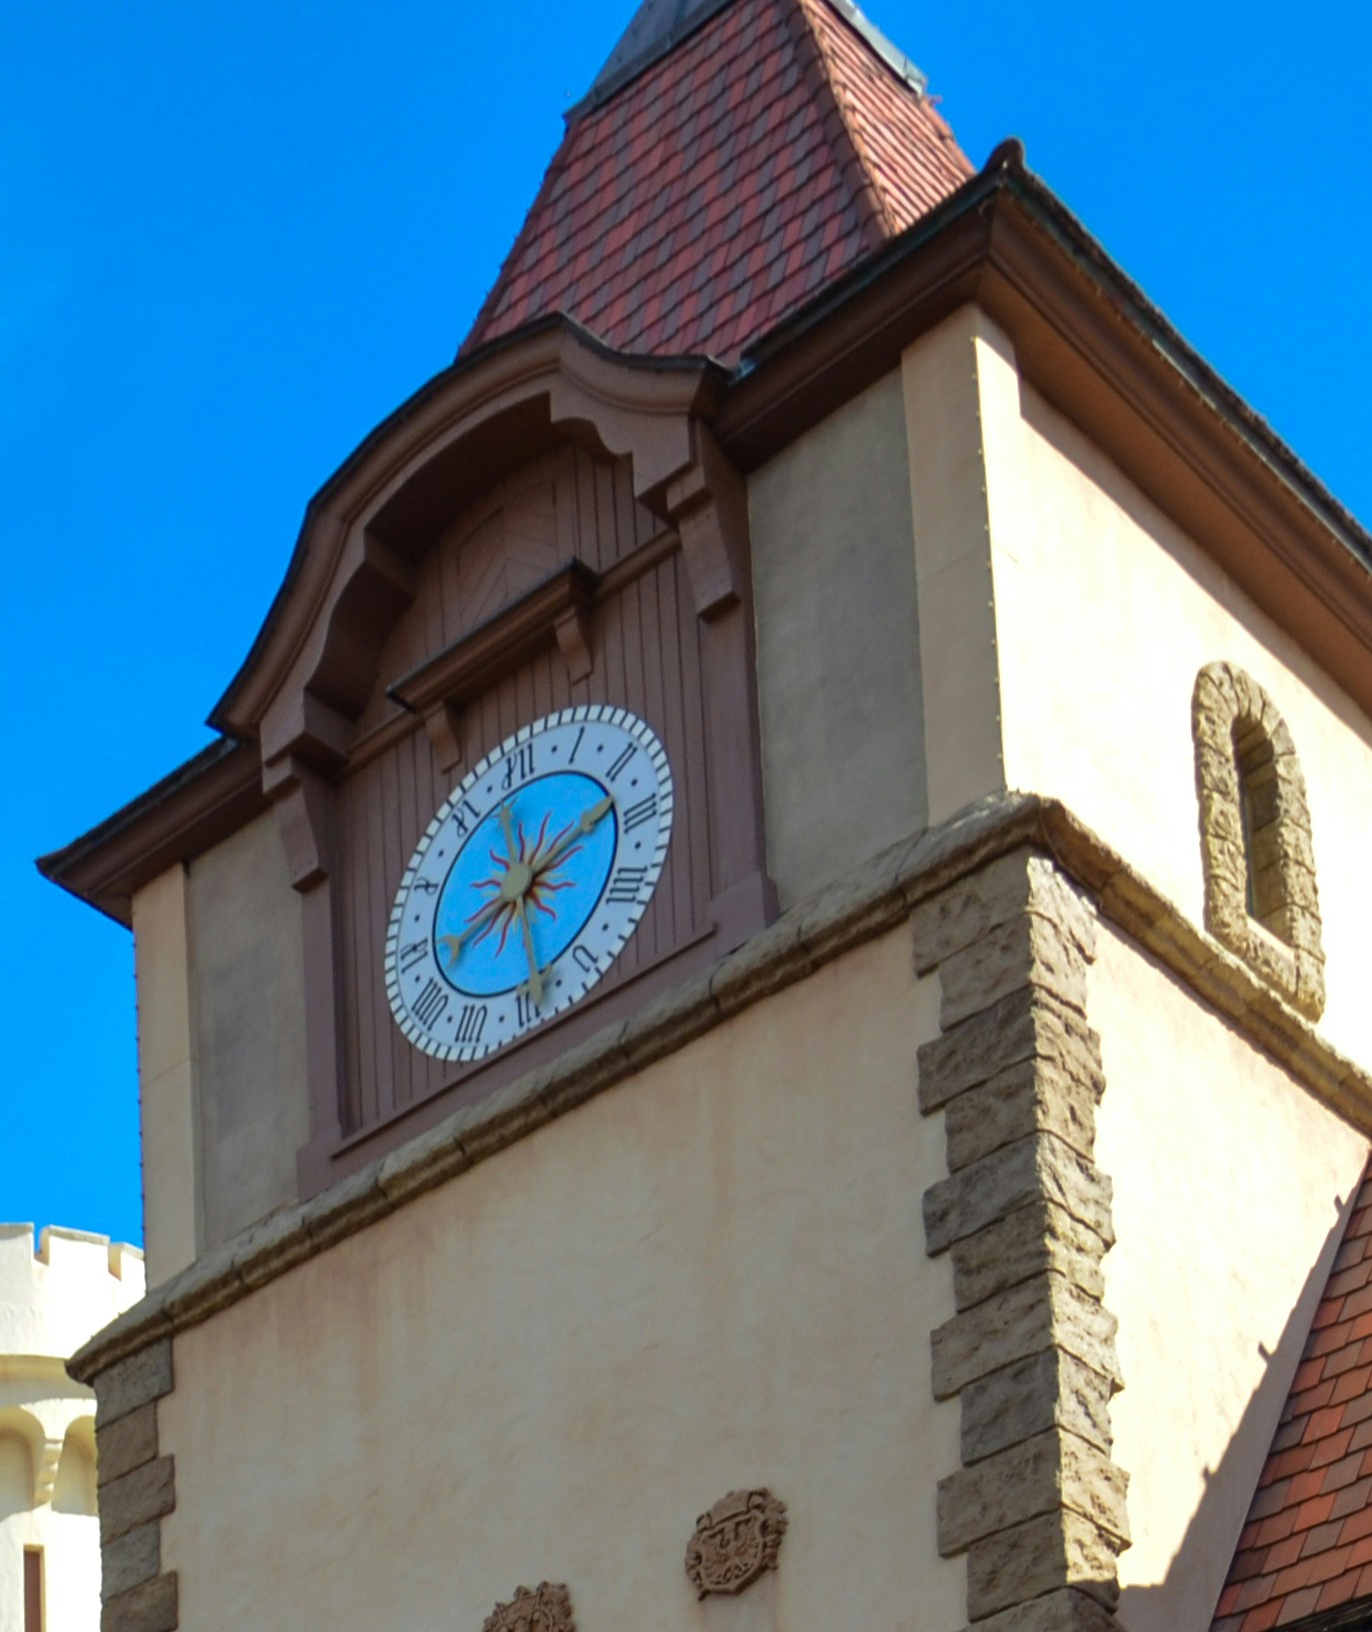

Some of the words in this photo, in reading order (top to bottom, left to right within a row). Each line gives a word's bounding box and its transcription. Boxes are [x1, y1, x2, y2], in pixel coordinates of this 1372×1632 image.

[569, 726, 585, 765] I
[605, 742, 638, 783] II
[502, 743, 536, 790] XII
[624, 792, 658, 835] III
[606, 866, 648, 904] IIII
